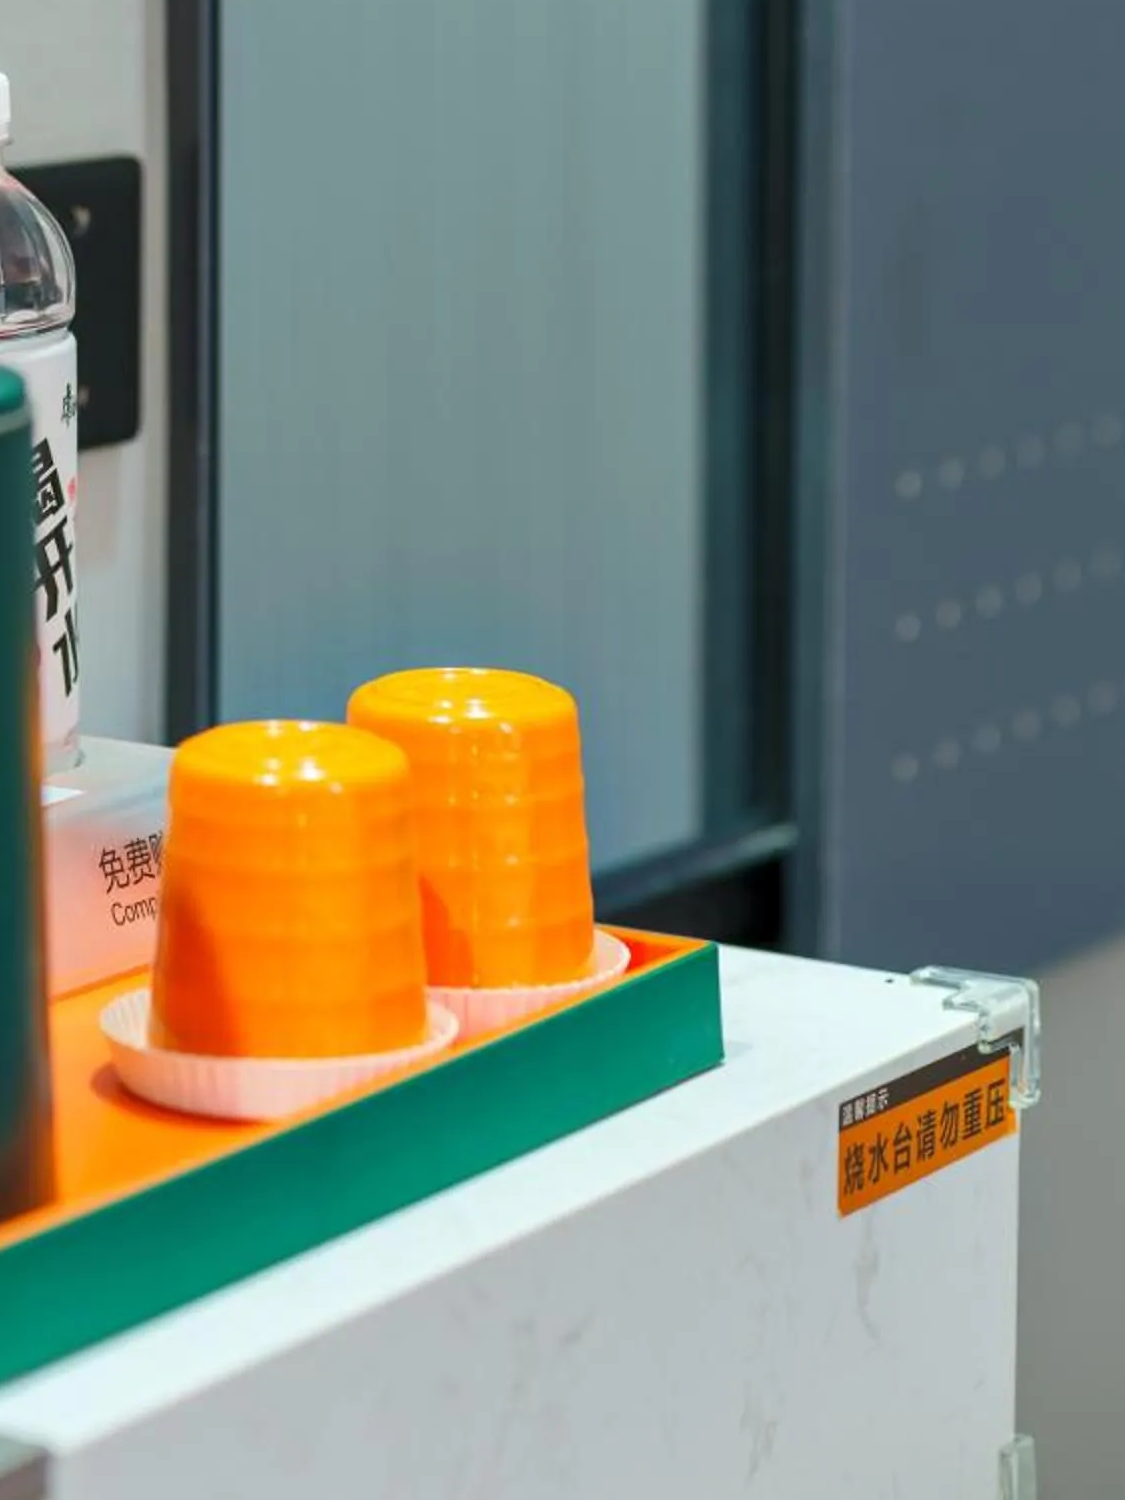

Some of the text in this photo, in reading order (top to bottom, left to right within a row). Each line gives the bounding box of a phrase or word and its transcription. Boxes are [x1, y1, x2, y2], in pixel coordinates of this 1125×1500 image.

[844, 1077, 1006, 1195] 烧水台请勿重压
